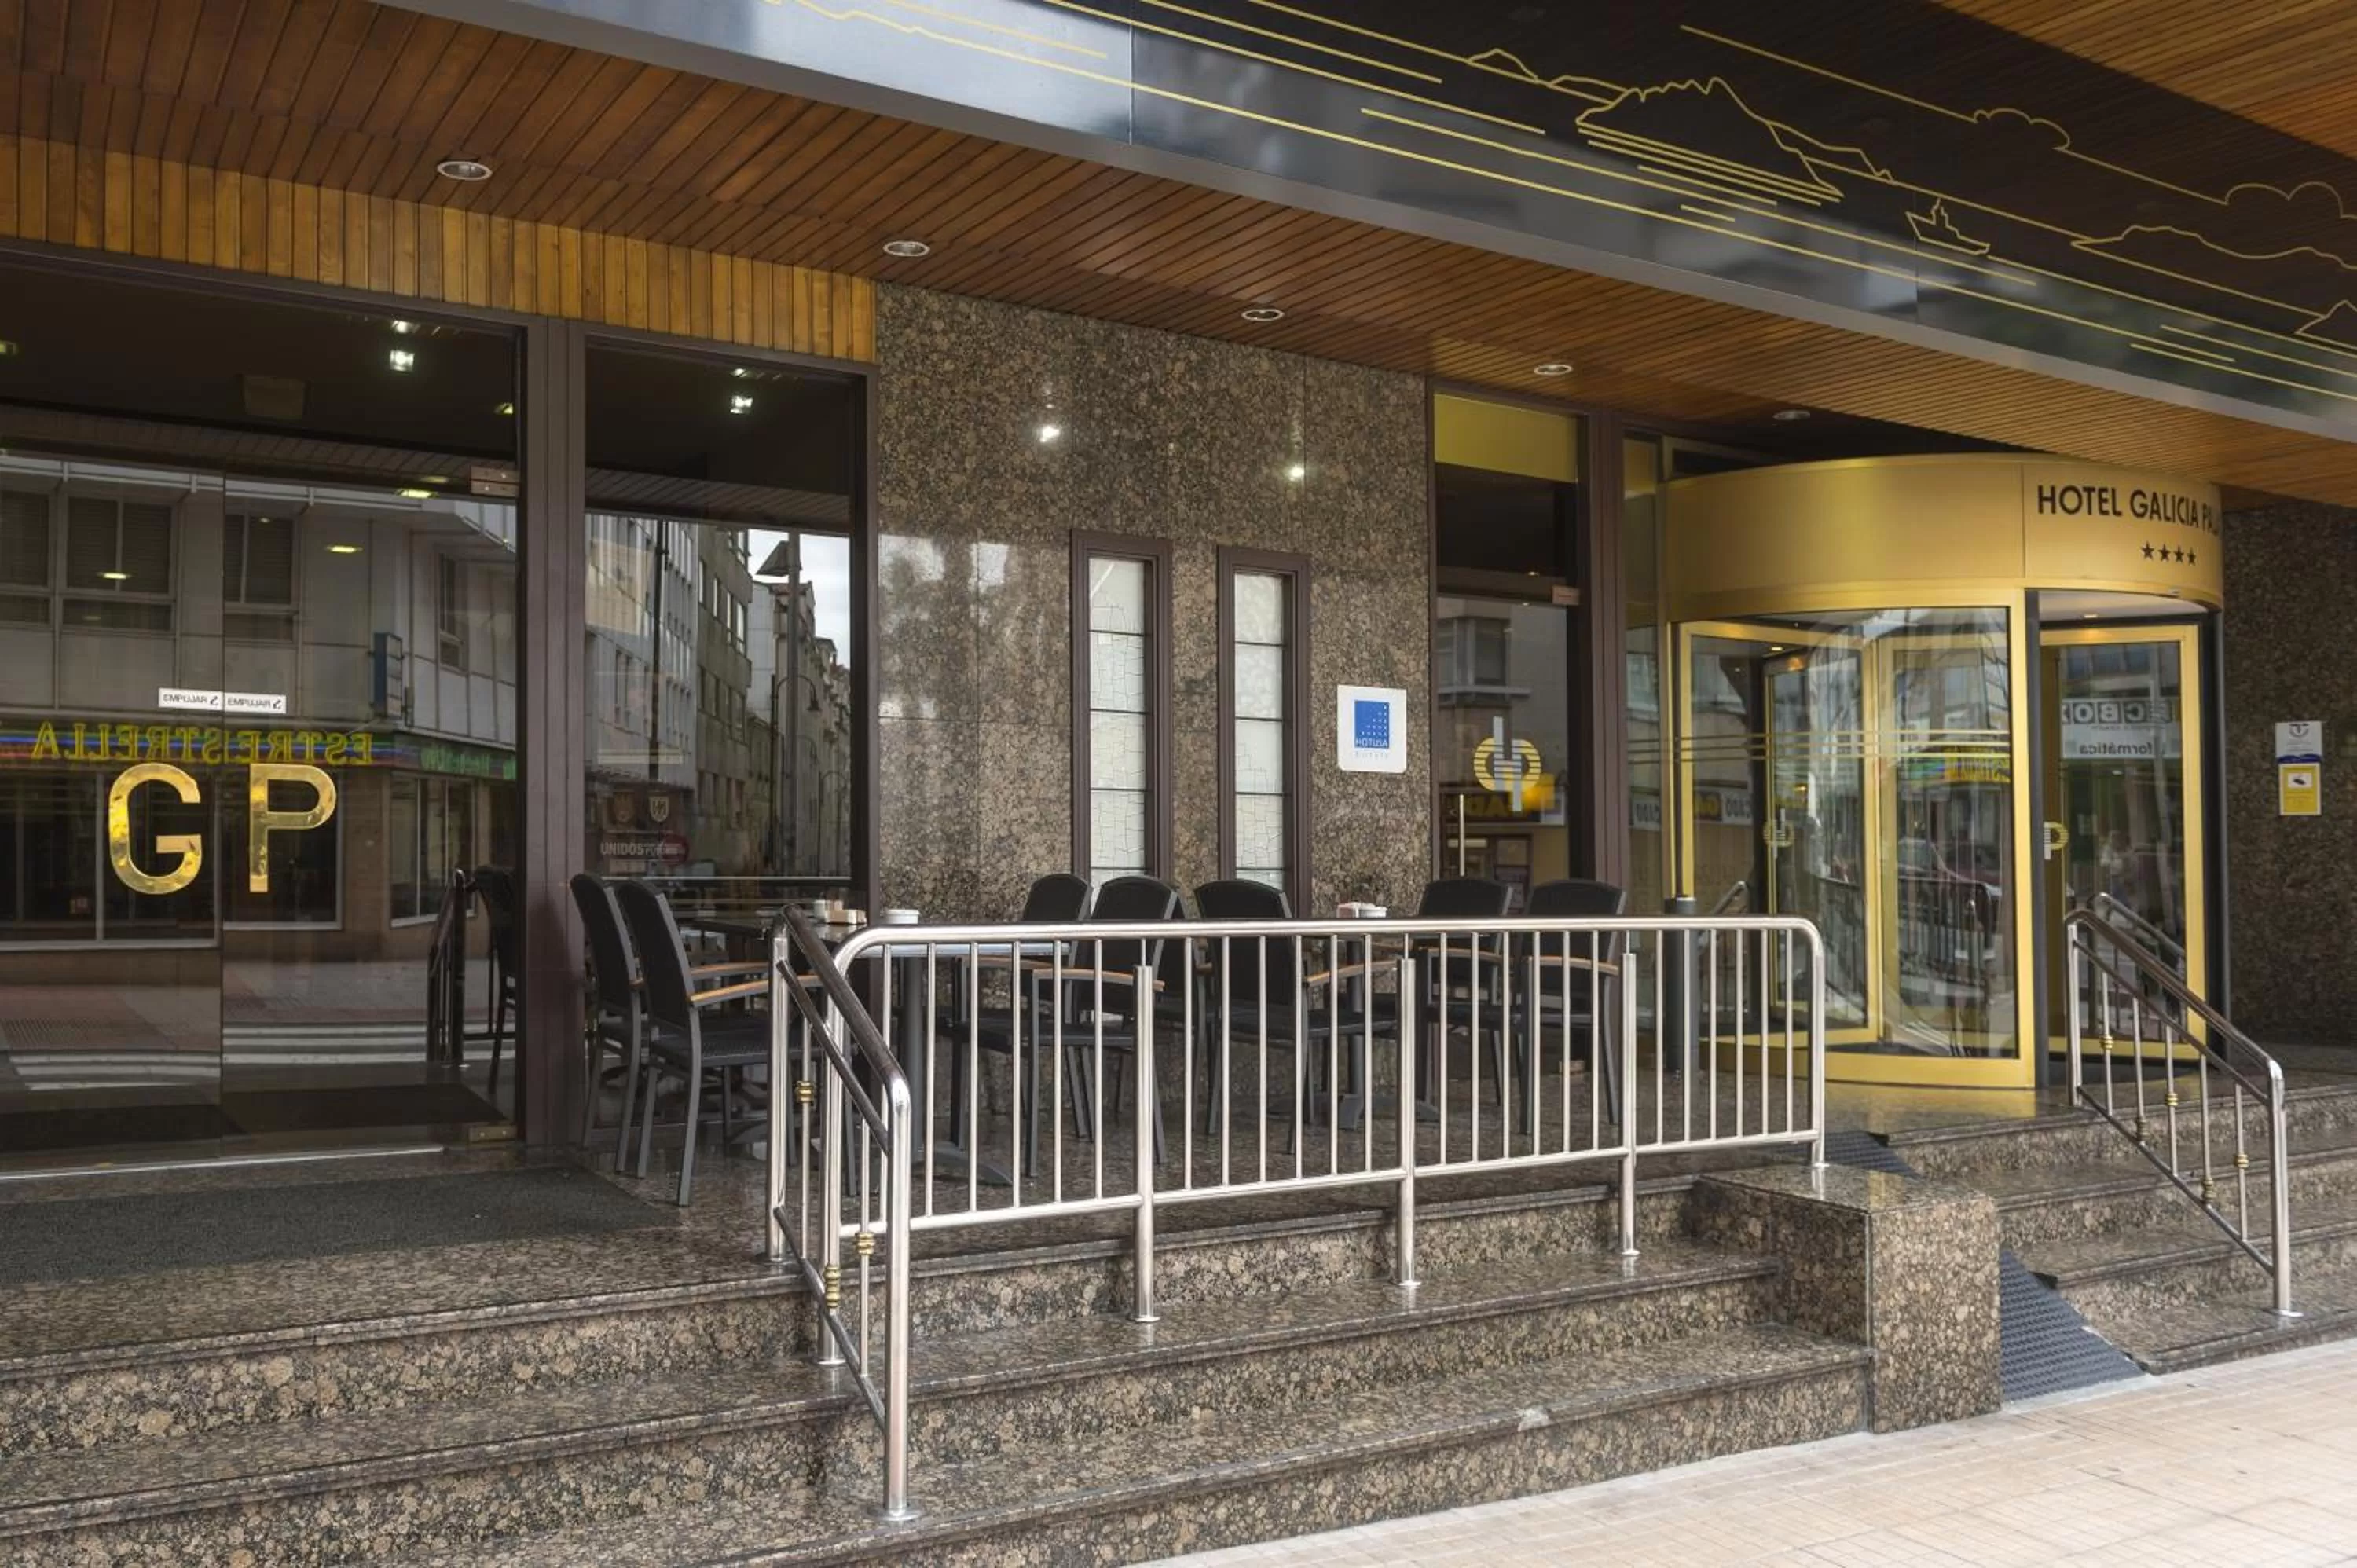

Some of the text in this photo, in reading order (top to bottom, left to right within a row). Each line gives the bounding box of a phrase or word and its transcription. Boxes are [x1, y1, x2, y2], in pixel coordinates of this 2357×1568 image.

[2038, 484, 2122, 517] HOTEL
[2130, 489, 2199, 529] GALICIA
[163, 693, 208, 704] EMPUJAR
[227, 697, 272, 709] EMPUJAR
[1356, 738, 1388, 748] HOTUSA
